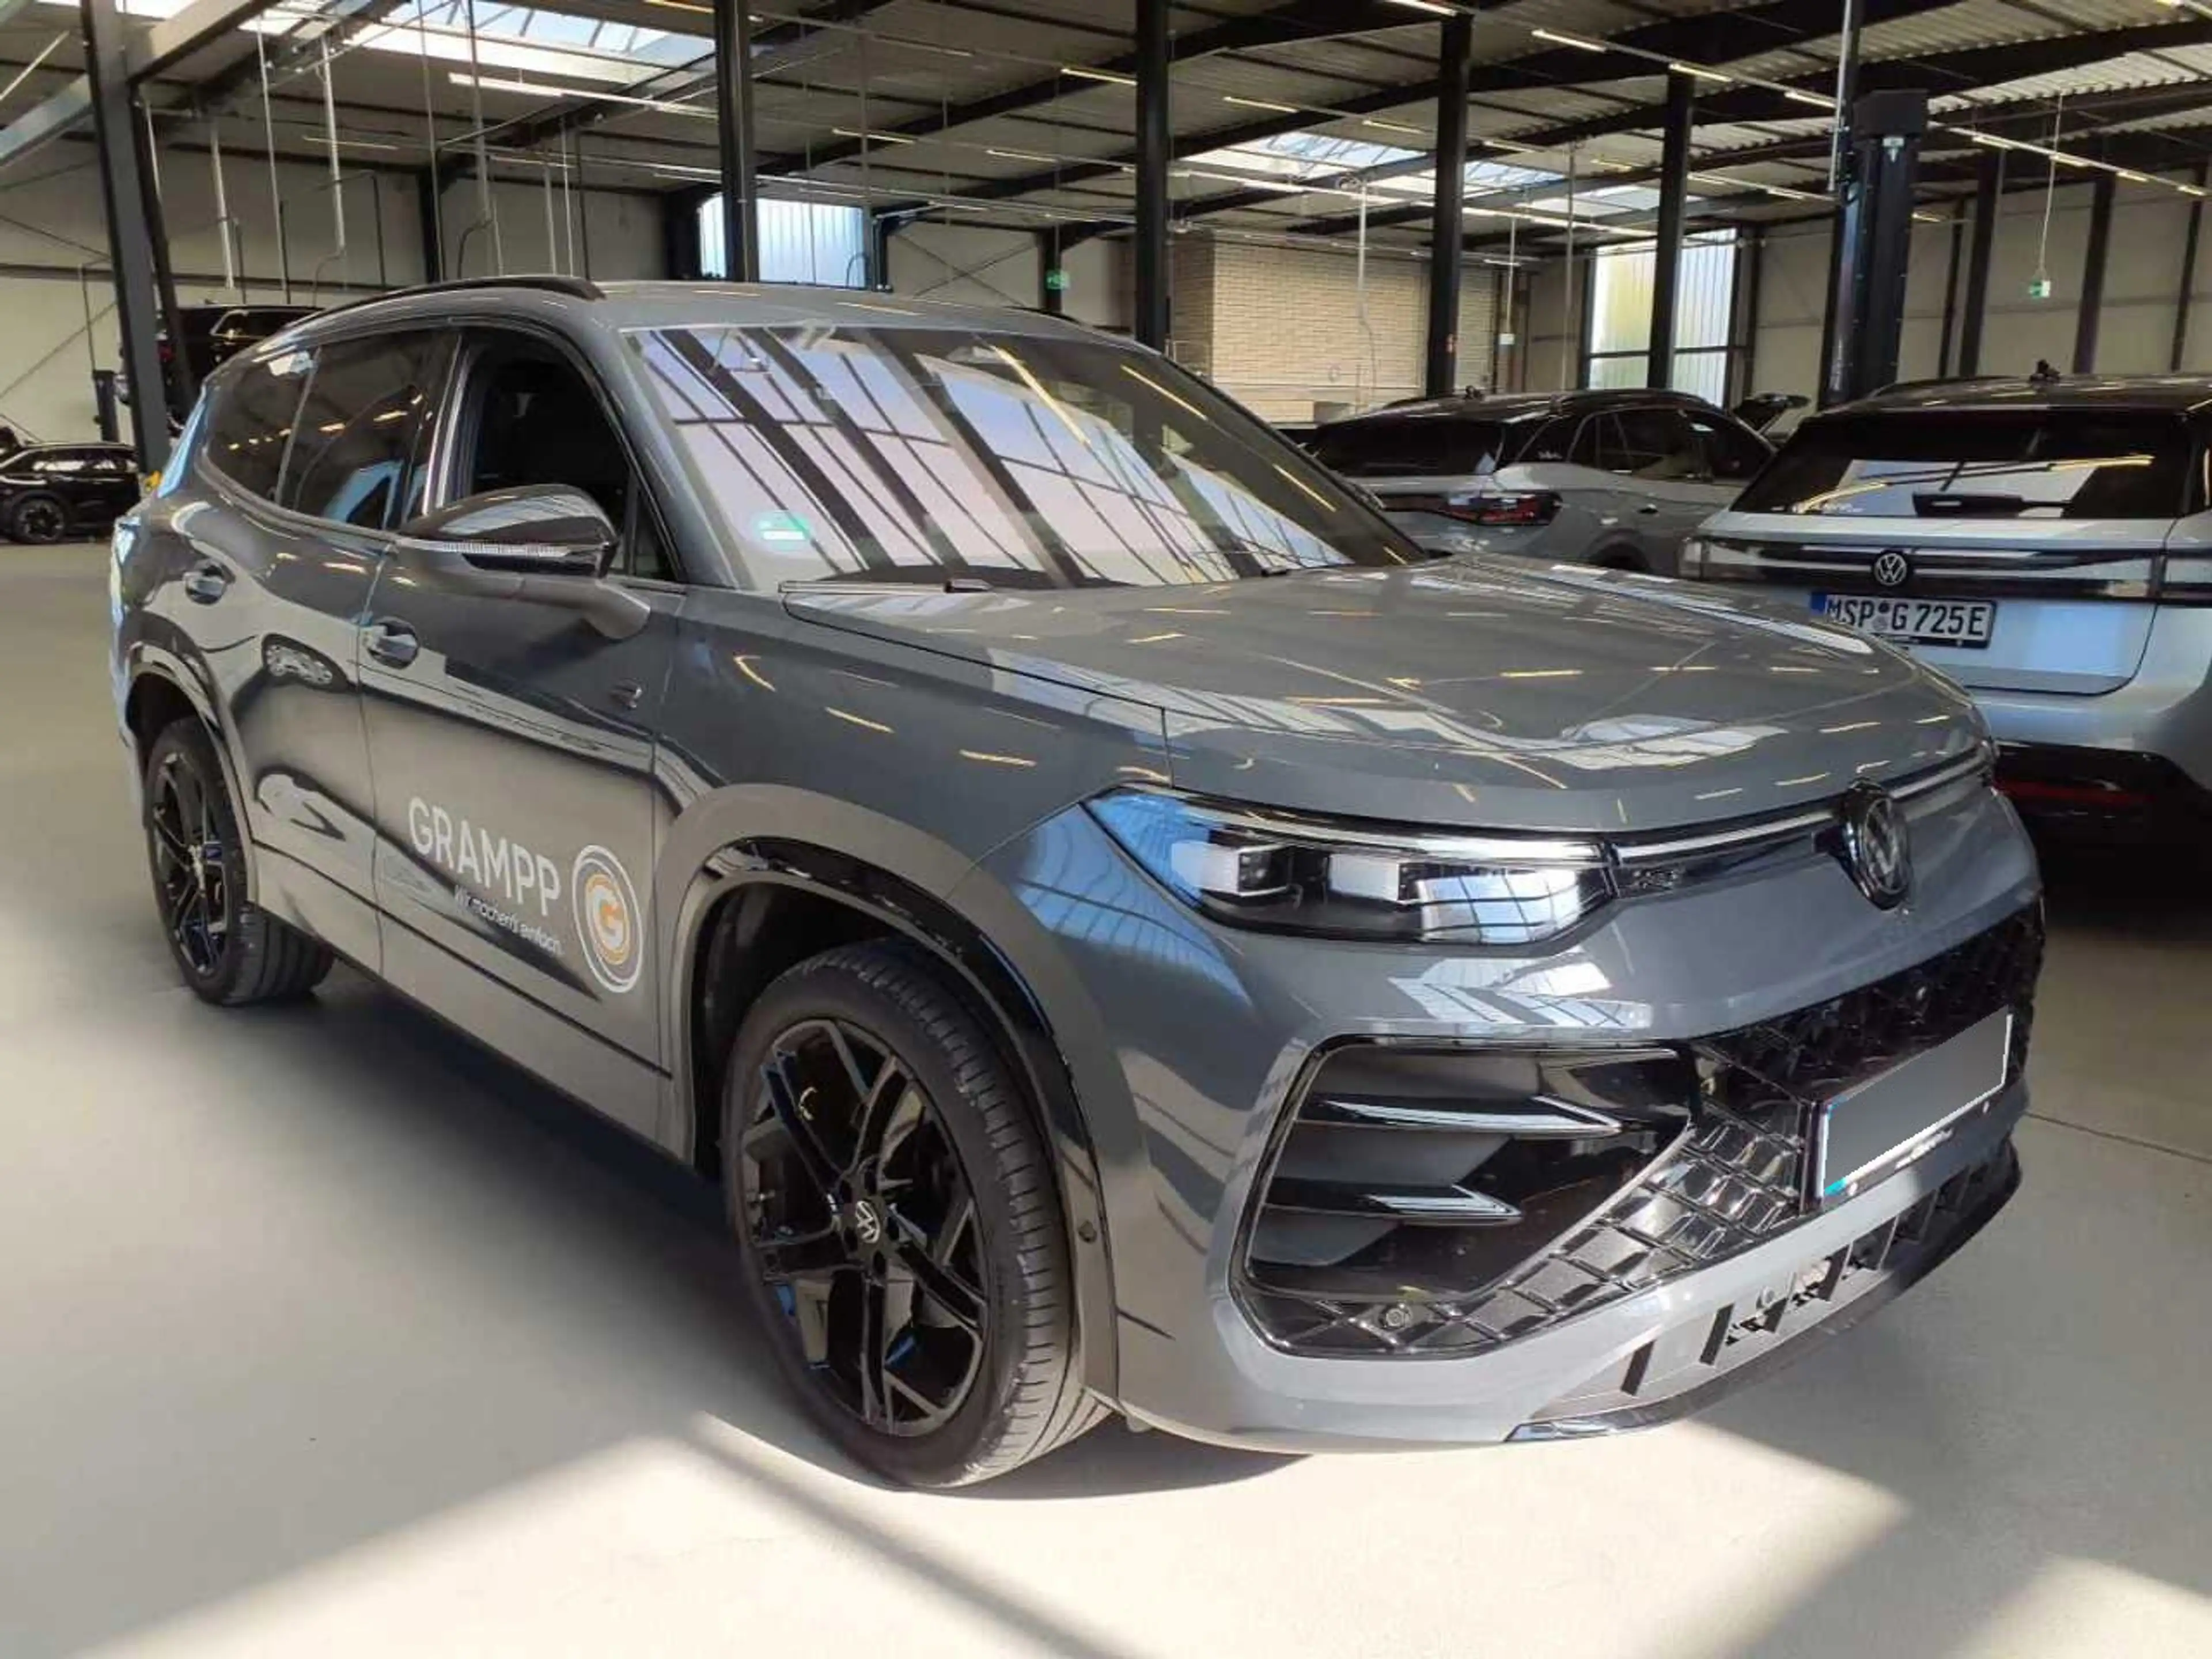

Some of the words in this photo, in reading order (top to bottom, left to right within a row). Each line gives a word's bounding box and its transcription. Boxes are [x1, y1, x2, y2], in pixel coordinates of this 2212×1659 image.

[1826, 599, 1874, 628] MSP
[1891, 602, 1909, 630] G
[1914, 604, 1987, 636] 725E
[409, 797, 561, 916] GRAMPP
